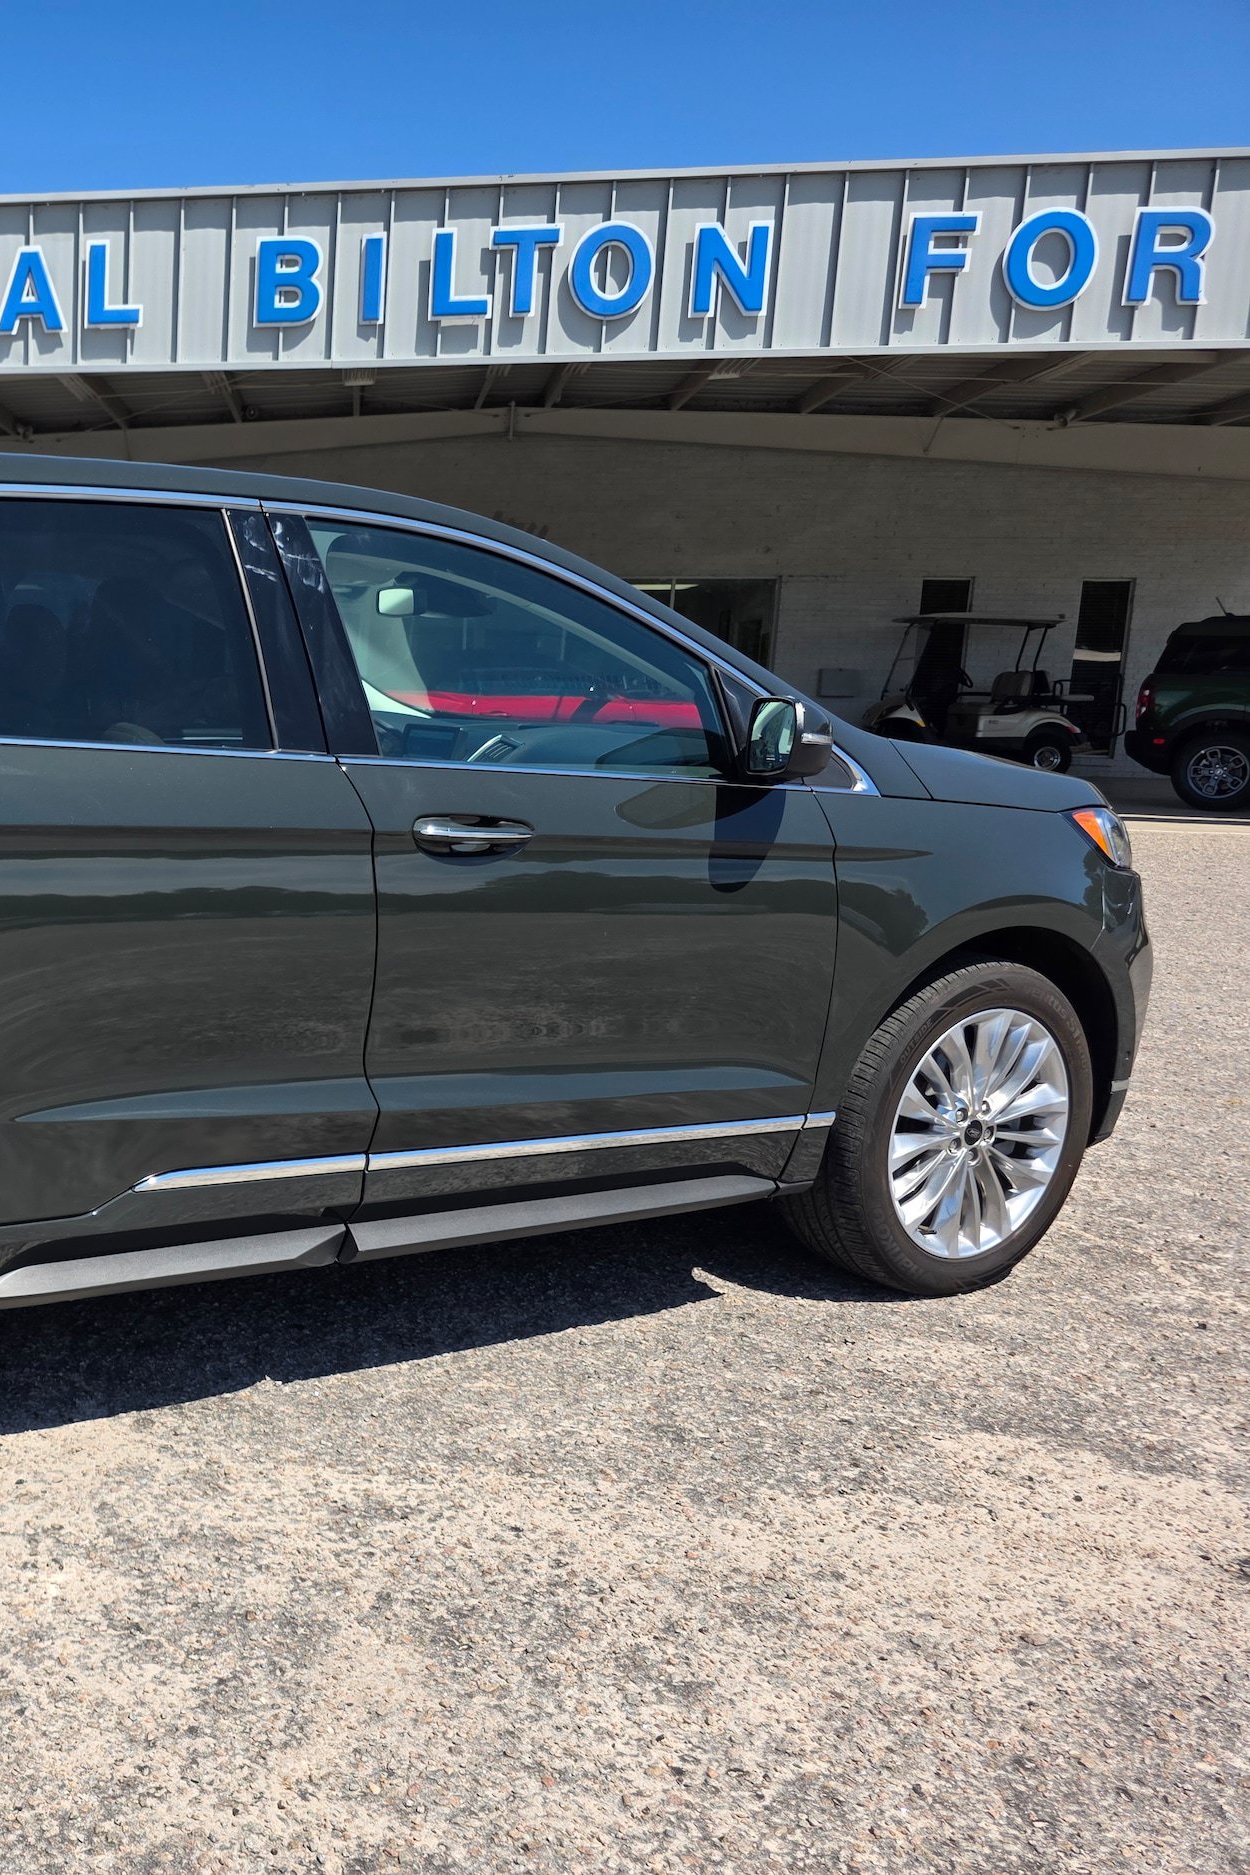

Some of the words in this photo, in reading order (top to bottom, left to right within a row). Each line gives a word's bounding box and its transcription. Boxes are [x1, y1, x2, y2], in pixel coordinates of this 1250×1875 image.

[253, 220, 774, 327] BILTON
[898, 206, 1216, 311] FOR
[900, 1018, 932, 1064] OUTSIDE
